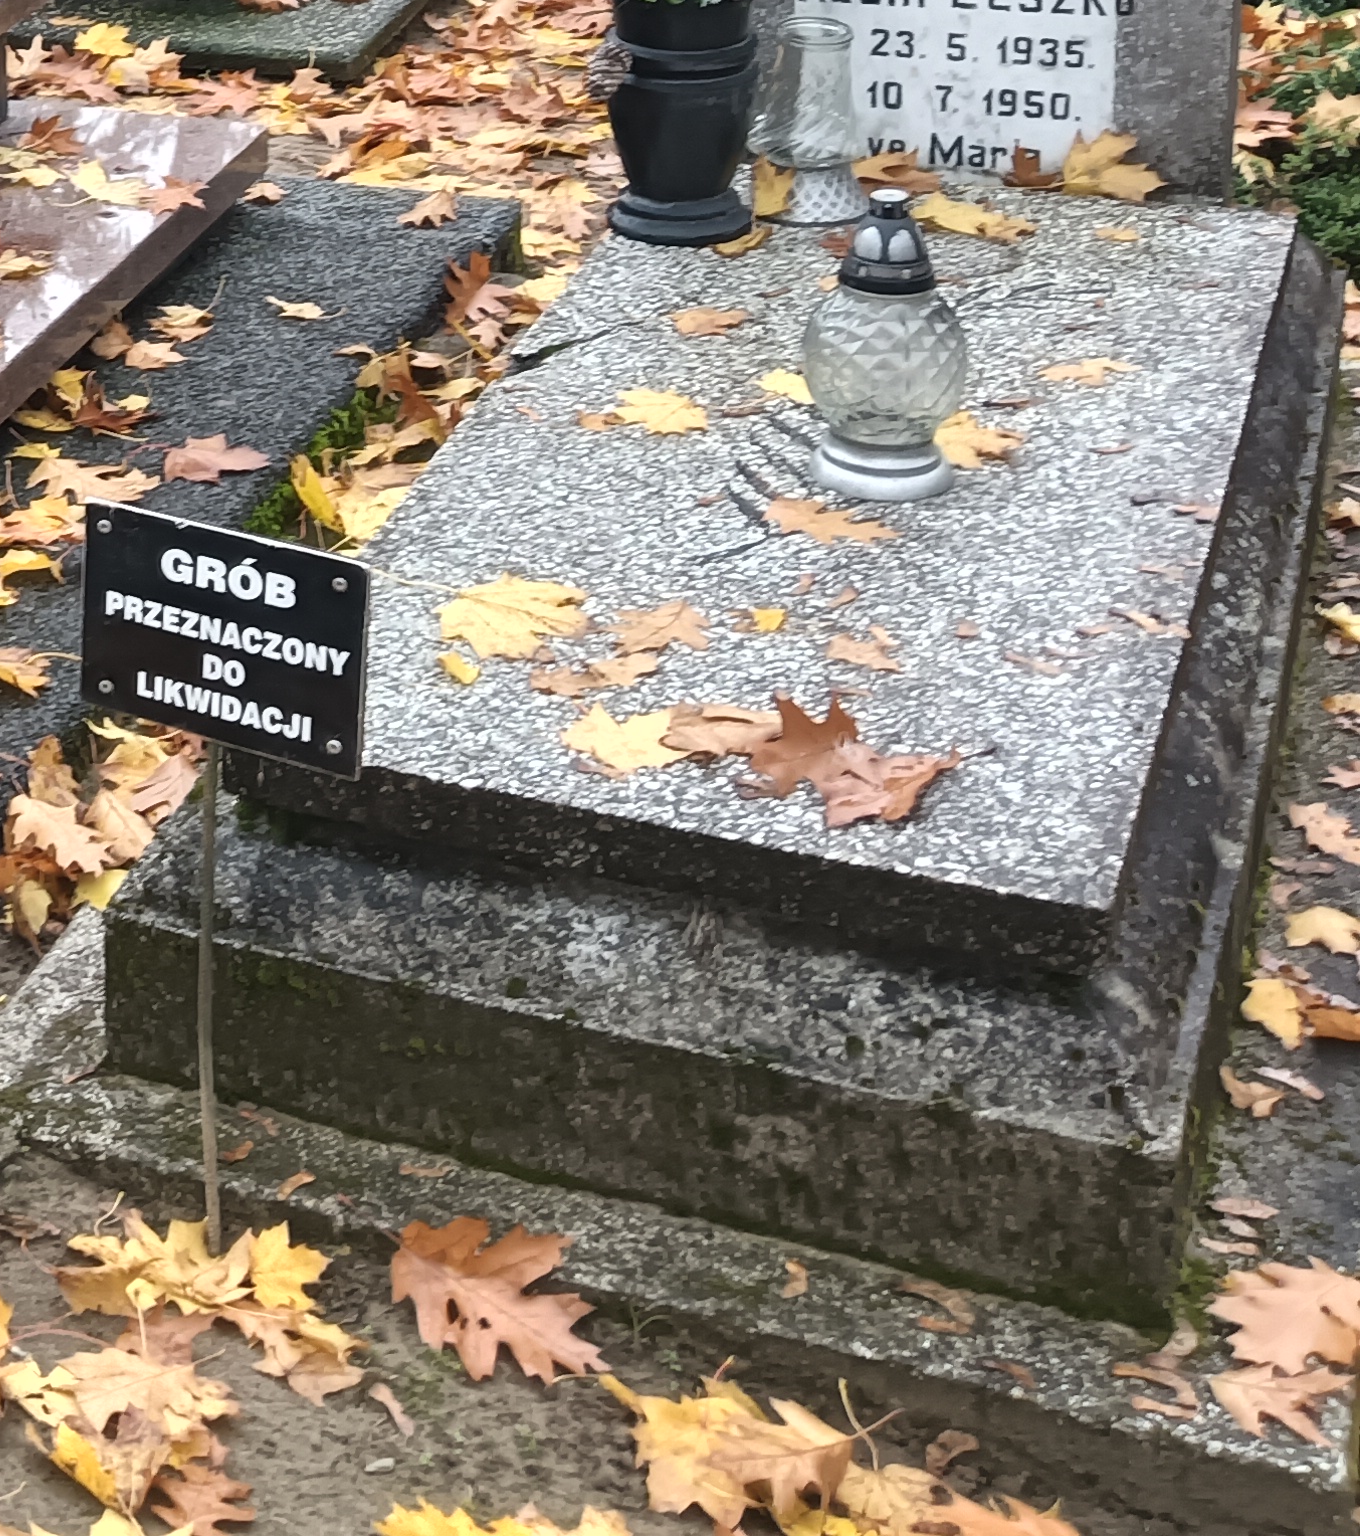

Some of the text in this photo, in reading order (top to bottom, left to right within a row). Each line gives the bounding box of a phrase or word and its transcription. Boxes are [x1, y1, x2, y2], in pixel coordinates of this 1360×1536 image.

[160, 547, 297, 609] GRÓB
[105, 590, 351, 676] PRZEZNACZONY
[201, 652, 246, 687] DO
[136, 670, 313, 743] LIKWIDACJI
